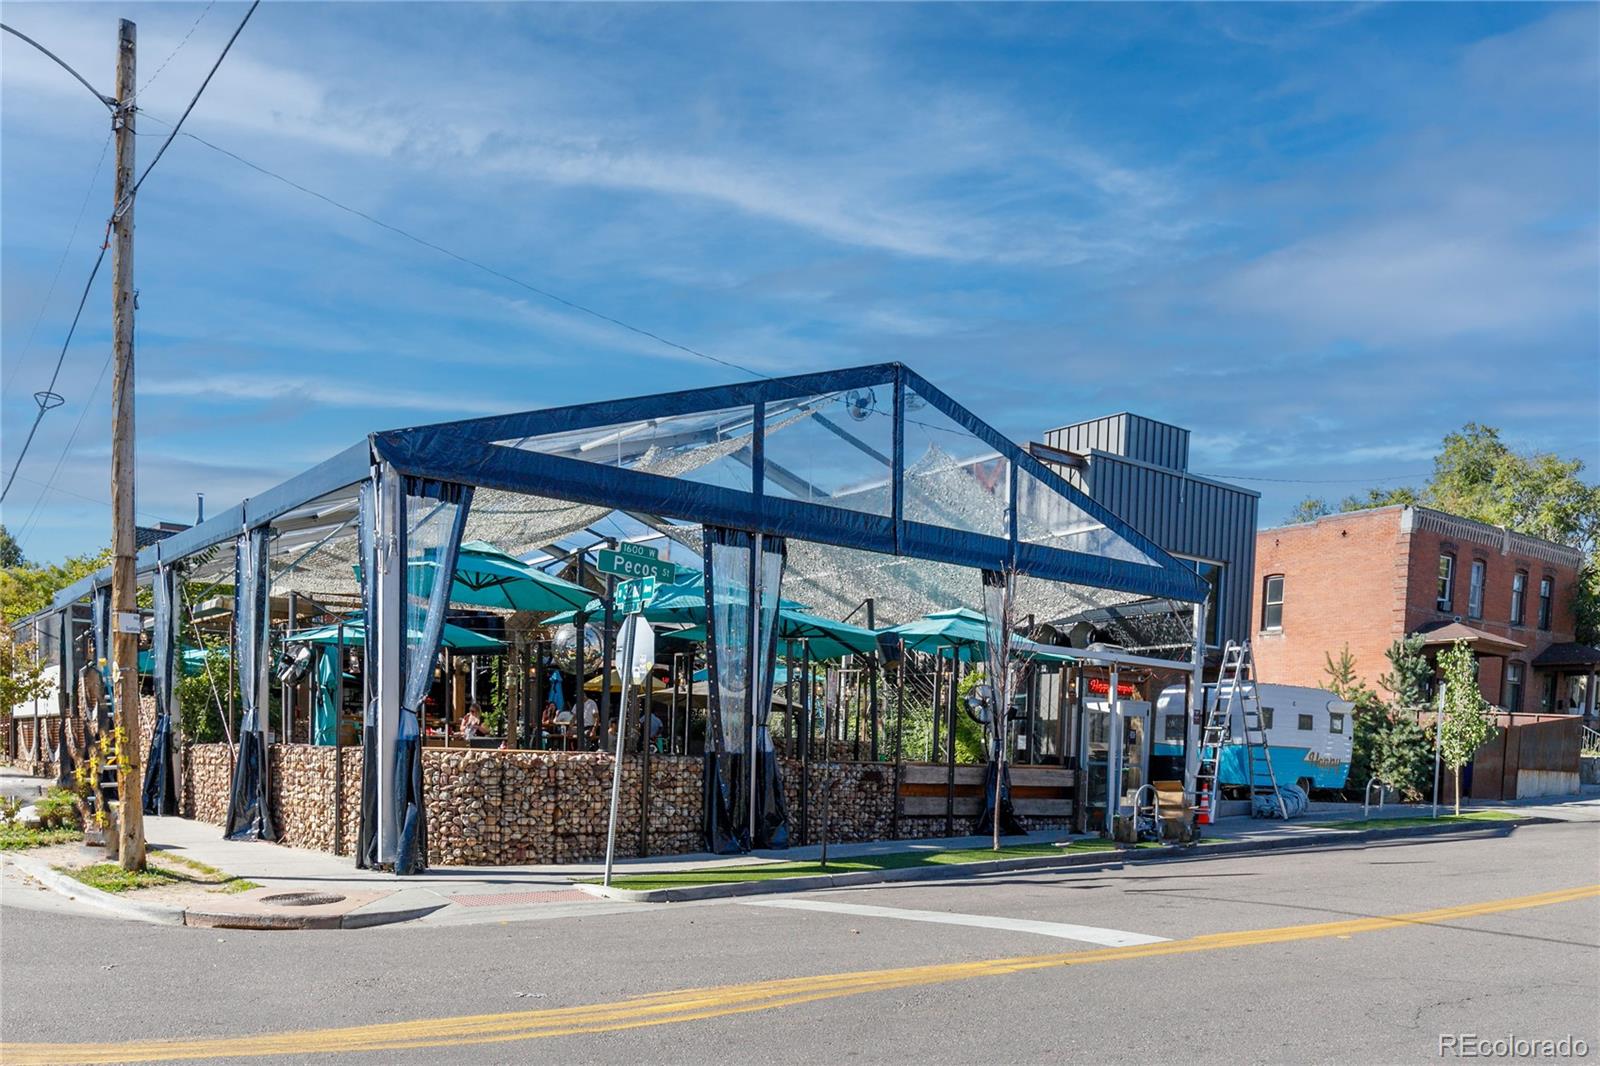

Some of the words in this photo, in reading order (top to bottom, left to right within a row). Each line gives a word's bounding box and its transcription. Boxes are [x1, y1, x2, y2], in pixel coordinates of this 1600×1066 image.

[623, 544, 644, 555] 1600
[649, 549, 656, 557] W
[614, 555, 658, 577] Pecos
[662, 569, 670, 577] St
